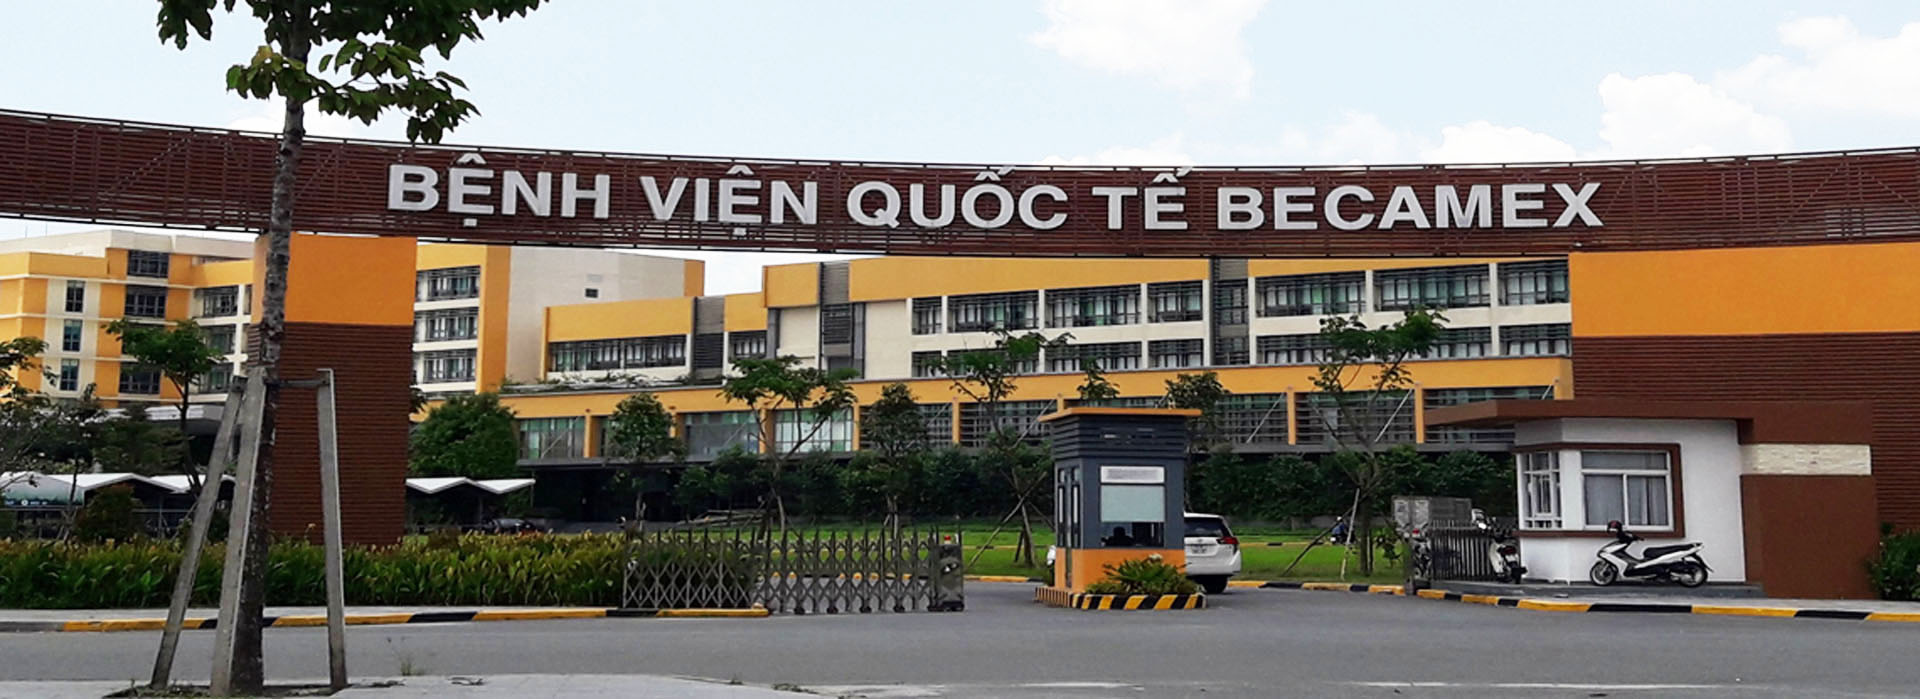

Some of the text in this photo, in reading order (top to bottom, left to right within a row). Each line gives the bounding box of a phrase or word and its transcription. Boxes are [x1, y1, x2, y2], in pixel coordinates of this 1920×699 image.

[388, 153, 1603, 236] BỆNH VIỆN QUỐC TẾ BECAMEX
